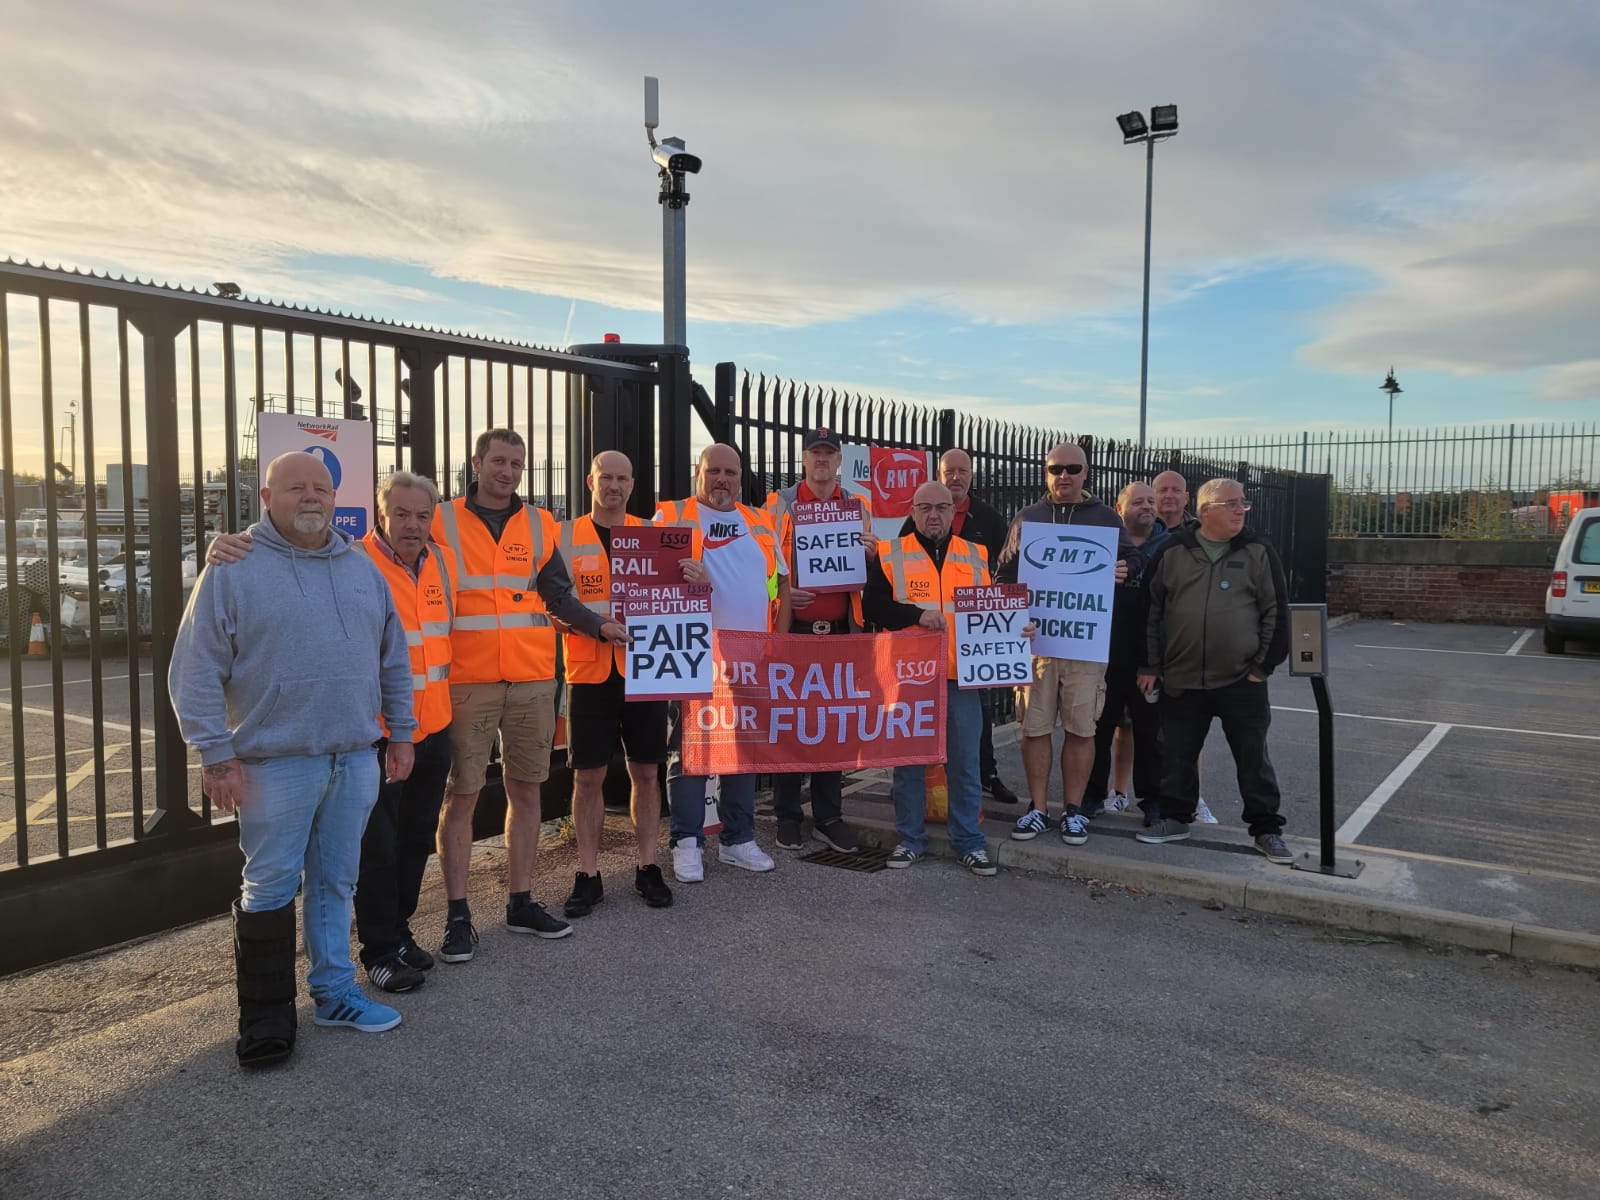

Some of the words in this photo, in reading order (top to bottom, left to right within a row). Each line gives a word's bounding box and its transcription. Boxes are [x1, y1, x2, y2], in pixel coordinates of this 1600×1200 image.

[852, 459, 871, 479] Ne
[885, 468, 919, 489] RMT
[797, 503, 812, 511] OUR
[814, 501, 841, 512] RAIL
[335, 516, 358, 527] PPE
[797, 513, 813, 521] OUR
[815, 510, 860, 522] FUTURE
[660, 531, 690, 545] tssa
[709, 522, 739, 538] NIKE
[612, 537, 640, 550] OUR
[796, 531, 864, 551] SAFER
[1041, 547, 1097, 564] RMT
[611, 557, 659, 576] RAIL
[809, 555, 856, 574] RAIL
[580, 574, 603, 584] tssa
[910, 579, 930, 588] tssa
[628, 588, 649, 597] OUR
[651, 587, 685, 600] RAIL
[956, 588, 974, 596] OUR
[976, 586, 1005, 599] RAIL
[629, 602, 649, 611] OUR
[651, 599, 709, 614] FUTURE
[957, 600, 975, 608] OUR
[977, 597, 1027, 611] FUTURE
[967, 611, 1017, 635] PAY
[628, 621, 711, 653] FAIR
[960, 640, 1027, 657] SAFETY
[632, 651, 707, 680] PAY
[895, 657, 937, 680] tssa
[963, 662, 1028, 683] JOBS
[768, 662, 871, 700] RAIL
[696, 705, 758, 731] OUR
[768, 699, 936, 745] FUTURE
